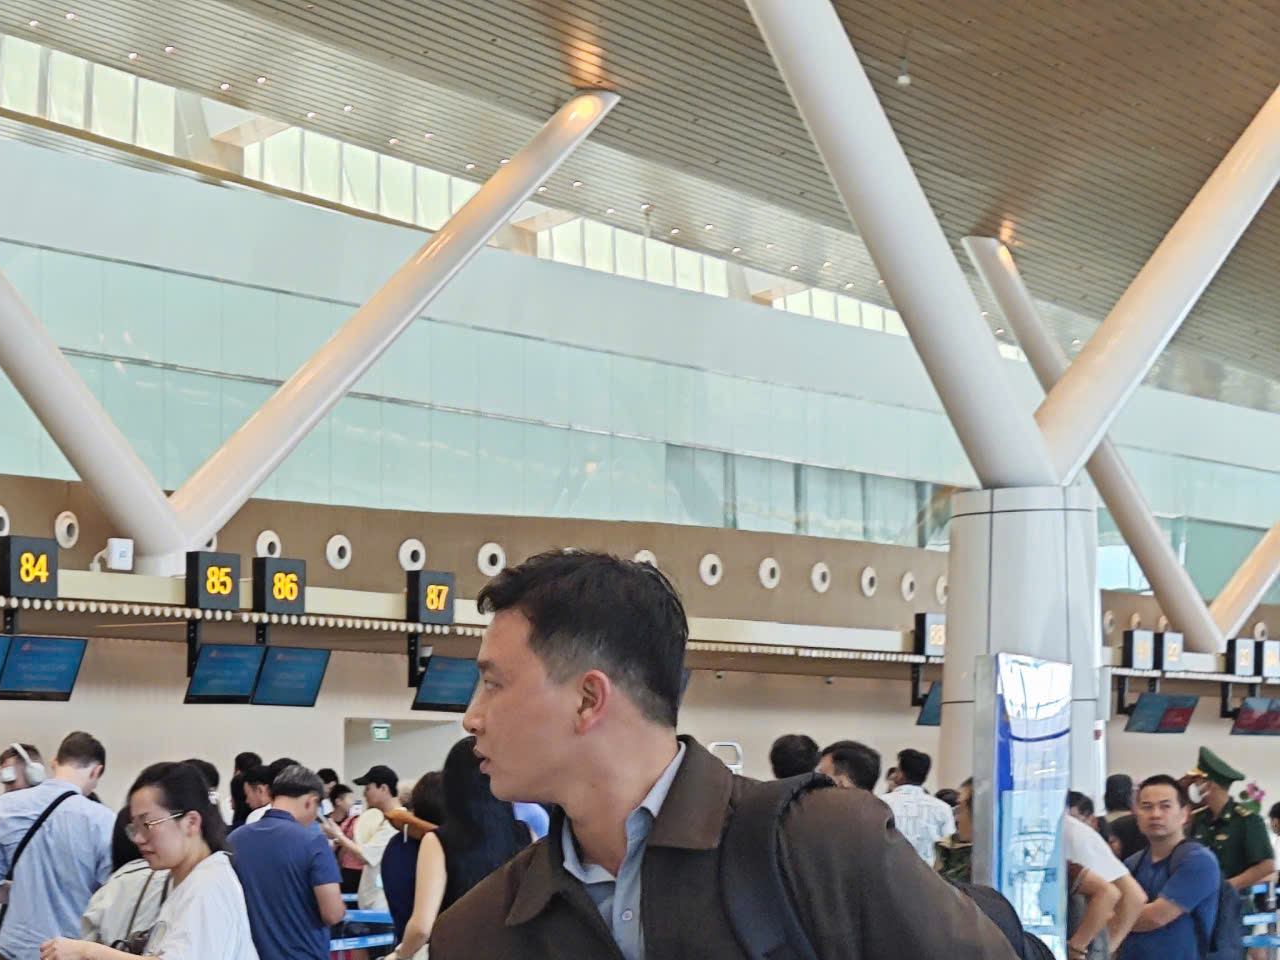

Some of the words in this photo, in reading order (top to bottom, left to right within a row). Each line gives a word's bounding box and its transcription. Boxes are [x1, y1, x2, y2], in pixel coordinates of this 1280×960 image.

[19, 552, 49, 584] 84
[205, 566, 233, 596] 85
[272, 572, 299, 601] 86
[426, 583, 450, 611] 87
